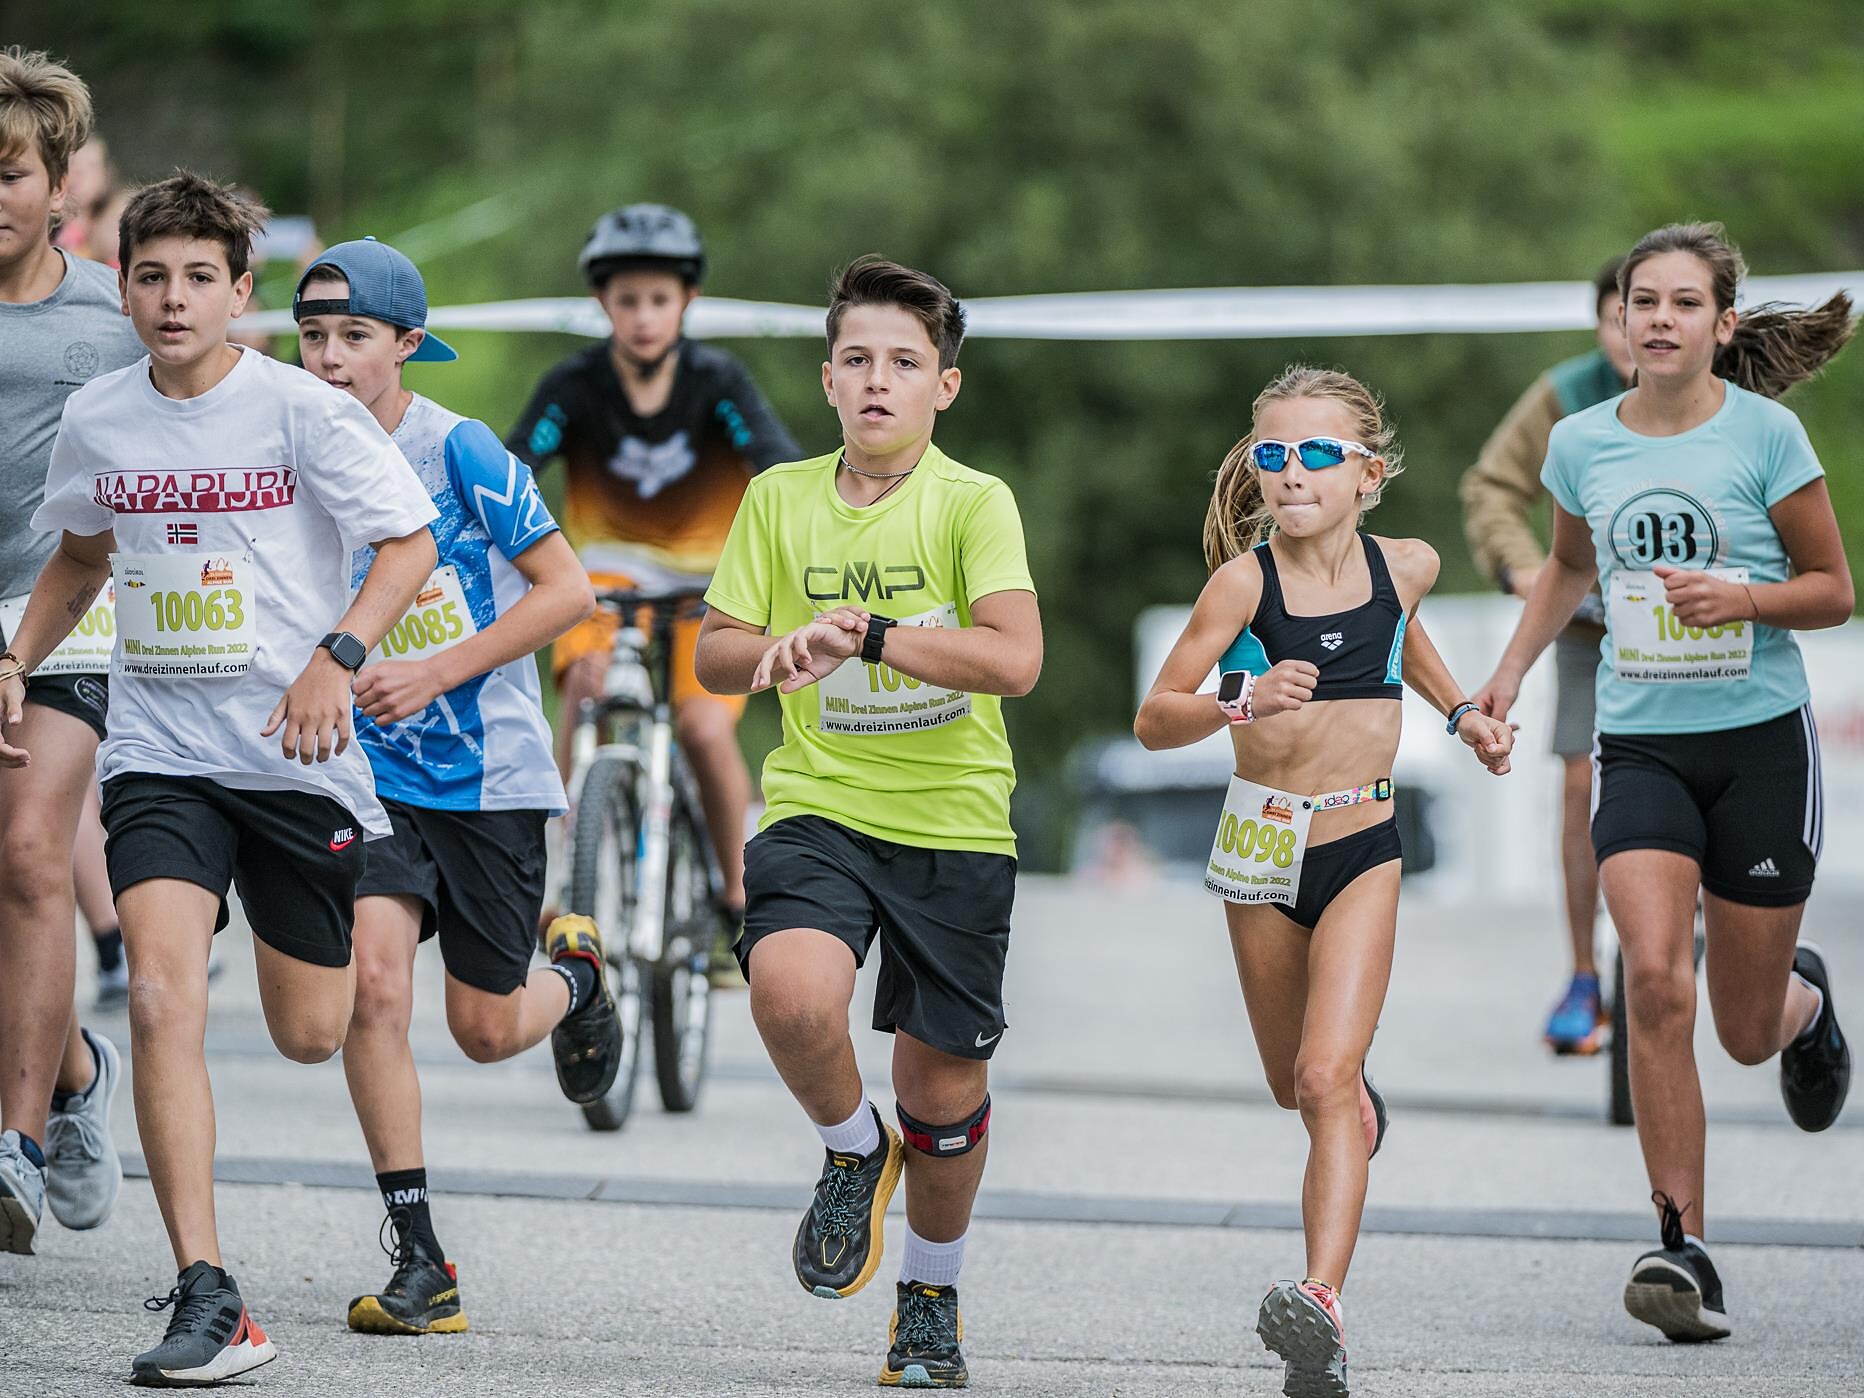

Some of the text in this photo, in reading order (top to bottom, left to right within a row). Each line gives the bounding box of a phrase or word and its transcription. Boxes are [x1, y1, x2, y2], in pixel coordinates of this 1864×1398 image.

[94, 469, 296, 511] NAPAPIJRI
[1627, 512, 1697, 564] 93
[804, 561, 926, 603] CMP
[150, 588, 245, 632] 10063
[124, 638, 248, 657] MINI Drei Zinnen Alpine Run 2022
[1320, 632, 1343, 641] arena
[124, 662, 248, 675] www.dreizinnenlauf.com
[862, 661, 935, 693] 10
[1620, 667, 1748, 679] www.dreizinnenlauf.com
[825, 690, 965, 715] MINI Drei Zinnen Alpine Run 2022
[826, 706, 966, 732] www.dreizinnenlauf.com
[333, 827, 354, 843] NIKE
[1225, 867, 1250, 884] Alpine
[1250, 874, 1269, 885] Run
[1270, 876, 1291, 887] 2022
